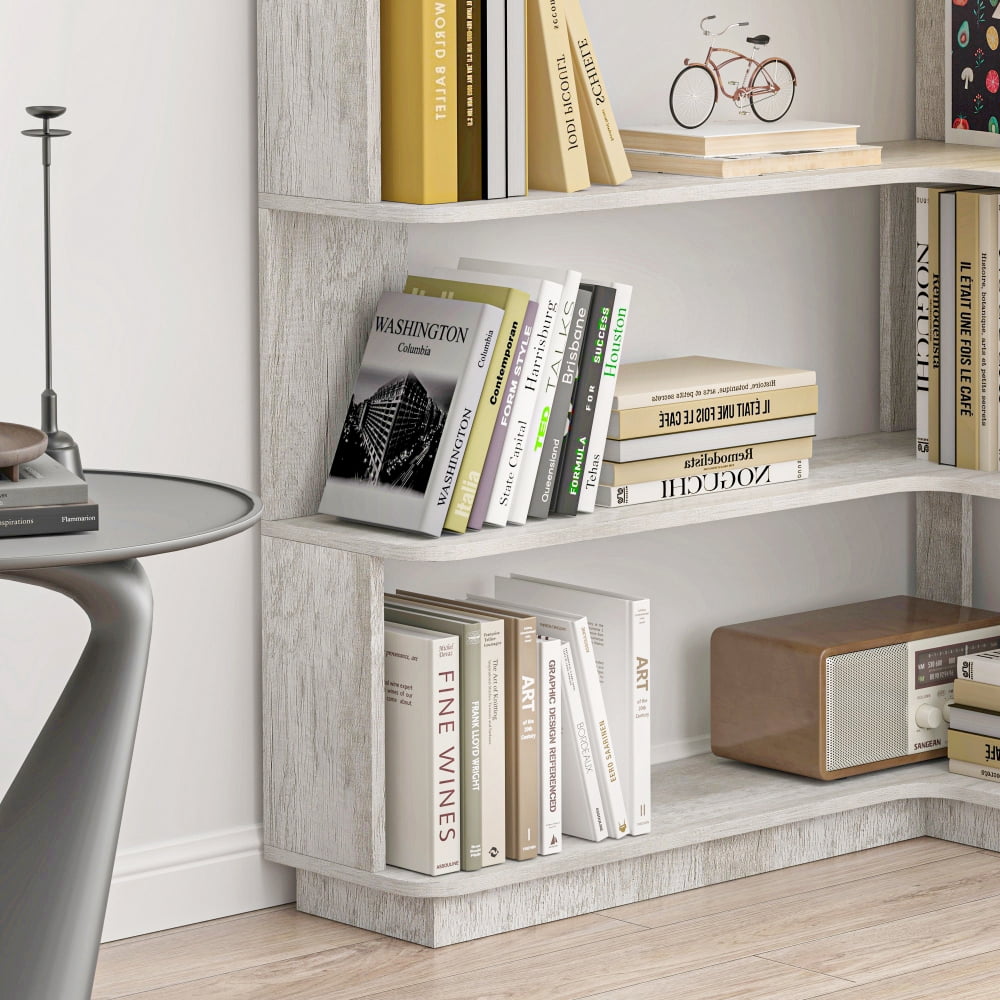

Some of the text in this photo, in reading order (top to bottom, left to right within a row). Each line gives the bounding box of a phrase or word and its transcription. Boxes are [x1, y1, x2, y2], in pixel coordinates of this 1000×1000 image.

[374, 315, 469, 344] WASHINGTON
[397, 342, 431, 357] Columbia
[524, 299, 558, 393] Harrisburg
[603, 307, 628, 378] Houston
[916, 241, 929, 392] NOGUCHI
[489, 320, 519, 406] Contemporan
[500, 324, 533, 427] FORM STYLE
[568, 306, 610, 496] FORMULA FOR SUCCESS
[436, 329, 494, 507] WASHINGTON Columbia
[533, 405, 551, 453] TED
[541, 306, 587, 503] Queensland Brisbane
[454, 470, 482, 519] Italia
[499, 419, 528, 507] State Capital
[61, 514, 96, 523] Flammarion
[438, 670, 455, 735] FINE
[521, 675, 536, 712] ART
[636, 656, 649, 692] ART
[471, 700, 480, 792] FRANK LLOYD WRIGHT
[548, 659, 557, 813] GRAPHIC DESIGN REFERENCED
[607, 763, 617, 783] EERO
[913, 738, 942, 751] SANGEAN
[438, 746, 456, 843] WINES
